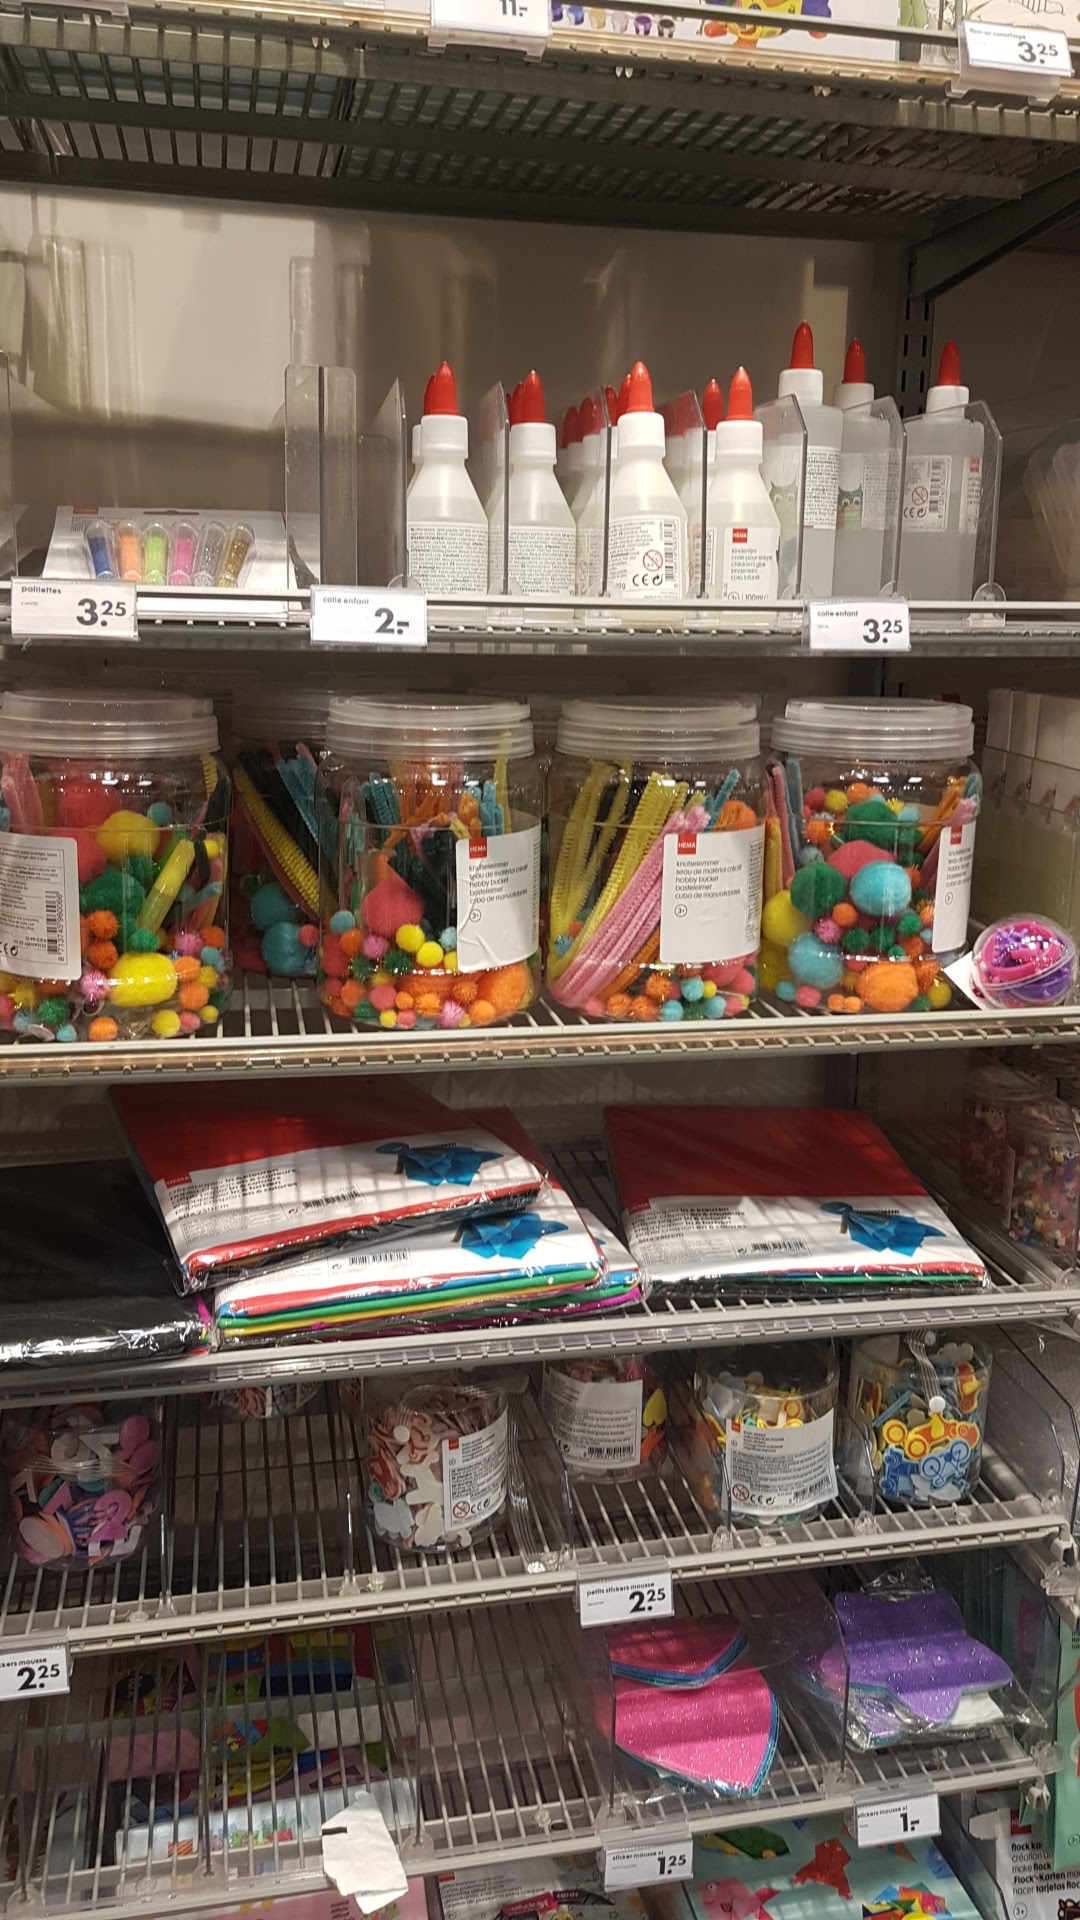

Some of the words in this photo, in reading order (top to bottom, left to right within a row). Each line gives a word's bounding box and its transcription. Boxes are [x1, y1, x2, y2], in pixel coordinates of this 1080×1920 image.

[323, 596, 342, 604] colle
[343, 597, 370, 605] enfant
[469, 844, 487, 853] HEMA
[678, 841, 696, 849] HEMA
[693, 867, 702, 875] de
[469, 880, 490, 889] hobby
[490, 877, 509, 886] bucket
[675, 876, 698, 886] hobby
[698, 875, 719, 883] bucket
[486, 895, 495, 903] de
[693, 891, 702, 899] de
[586, 1589, 604, 1597] petits
[630, 1582, 655, 1590] mousse
[629, 1588, 666, 1614] 2.25
[18, 1657, 47, 1666] mousse
[17, 1663, 60, 1691] 2.25
[857, 1810, 879, 1819] stickers
[879, 1807, 901, 1815] mousse
[1011, 1843, 1030, 1851] flock
[633, 1850, 657, 1858] mousse
[1011, 1852, 1043, 1863] création
[657, 1854, 687, 1876] 1.25
[1012, 1864, 1033, 1874] make
[1033, 1862, 1052, 1871] flock
[1012, 1885, 1034, 1896] hacer
[1035, 1882, 1066, 1893] tarjetas
